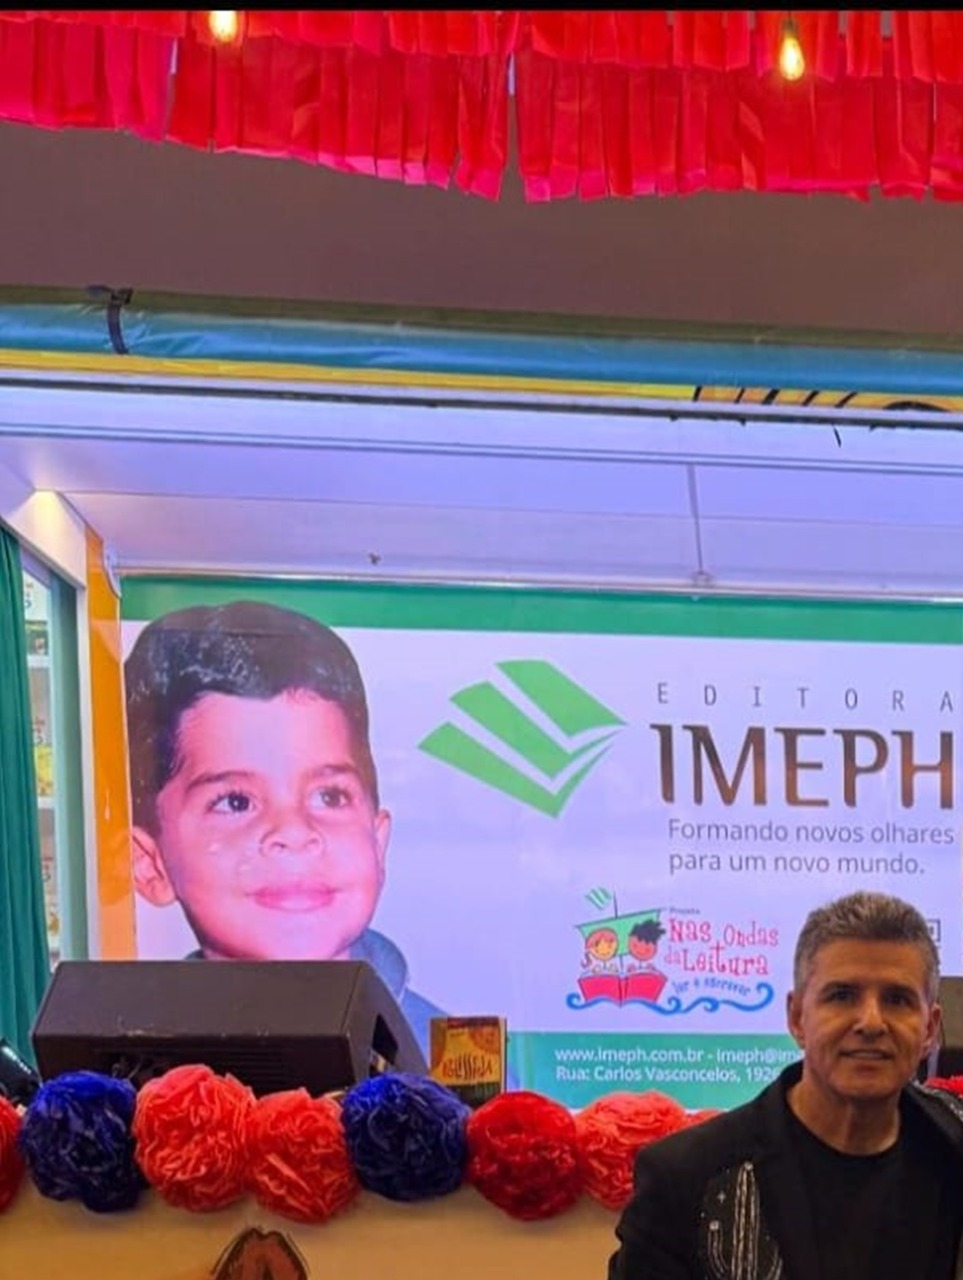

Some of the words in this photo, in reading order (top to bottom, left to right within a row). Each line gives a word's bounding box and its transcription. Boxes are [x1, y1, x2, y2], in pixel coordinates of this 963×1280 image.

[657, 682, 954, 712] EDITORA
[649, 723, 954, 810] IMEPH
[668, 819, 788, 843] Formando
[796, 824, 864, 844] novos
[871, 822, 954, 845] olhares
[669, 853, 721, 875] para
[729, 854, 766, 872] um
[774, 855, 830, 873] novo
[837, 853, 926, 875] mundo.
[722, 921, 779, 948] Ondas
[682, 943, 770, 977] Leitura
[555, 1046, 705, 1067] www.imeph.com.br
[556, 1066, 590, 1081] Rua:
[594, 1065, 642, 1081] Carlos
[646, 1066, 742, 1084] Vasconcelos,
